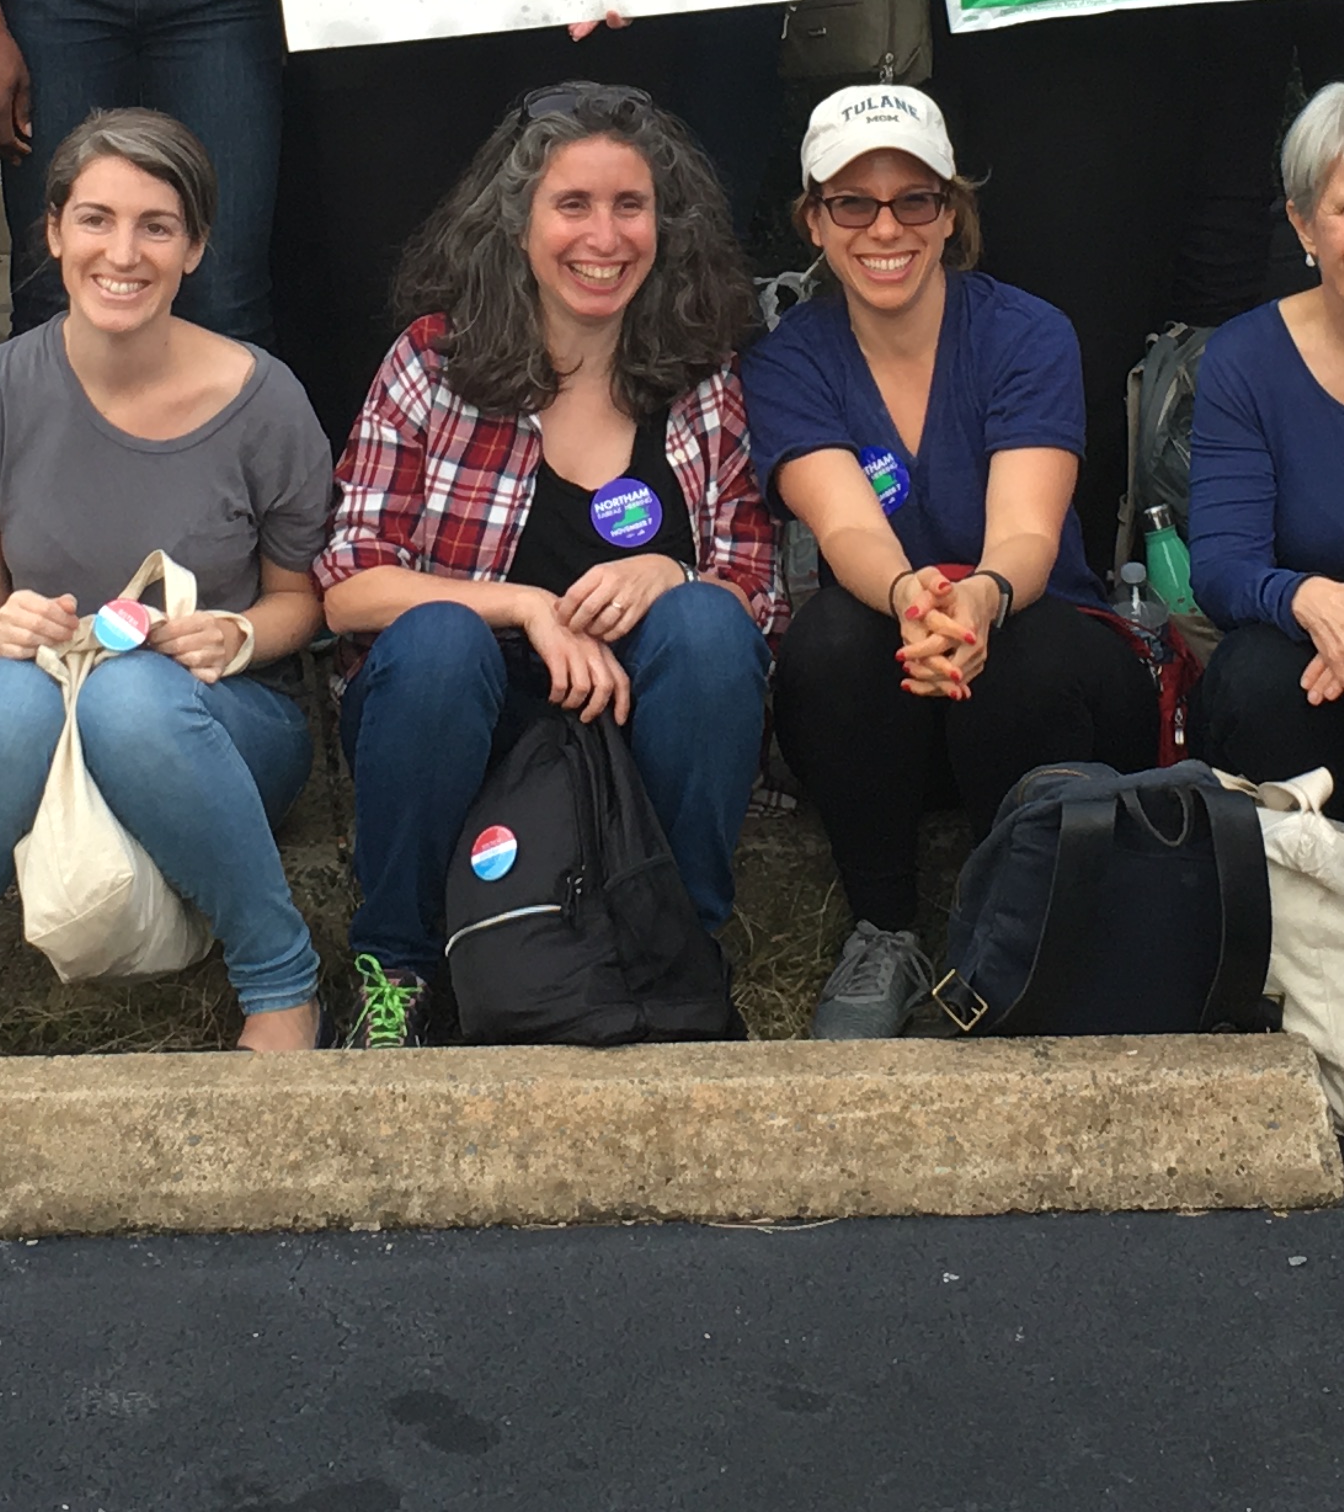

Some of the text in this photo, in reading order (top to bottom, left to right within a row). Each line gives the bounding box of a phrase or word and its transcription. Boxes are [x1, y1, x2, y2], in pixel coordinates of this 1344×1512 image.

[841, 94, 922, 123] TULANE
[865, 113, 901, 125] MOM
[594, 486, 650, 514] NORTHAM
